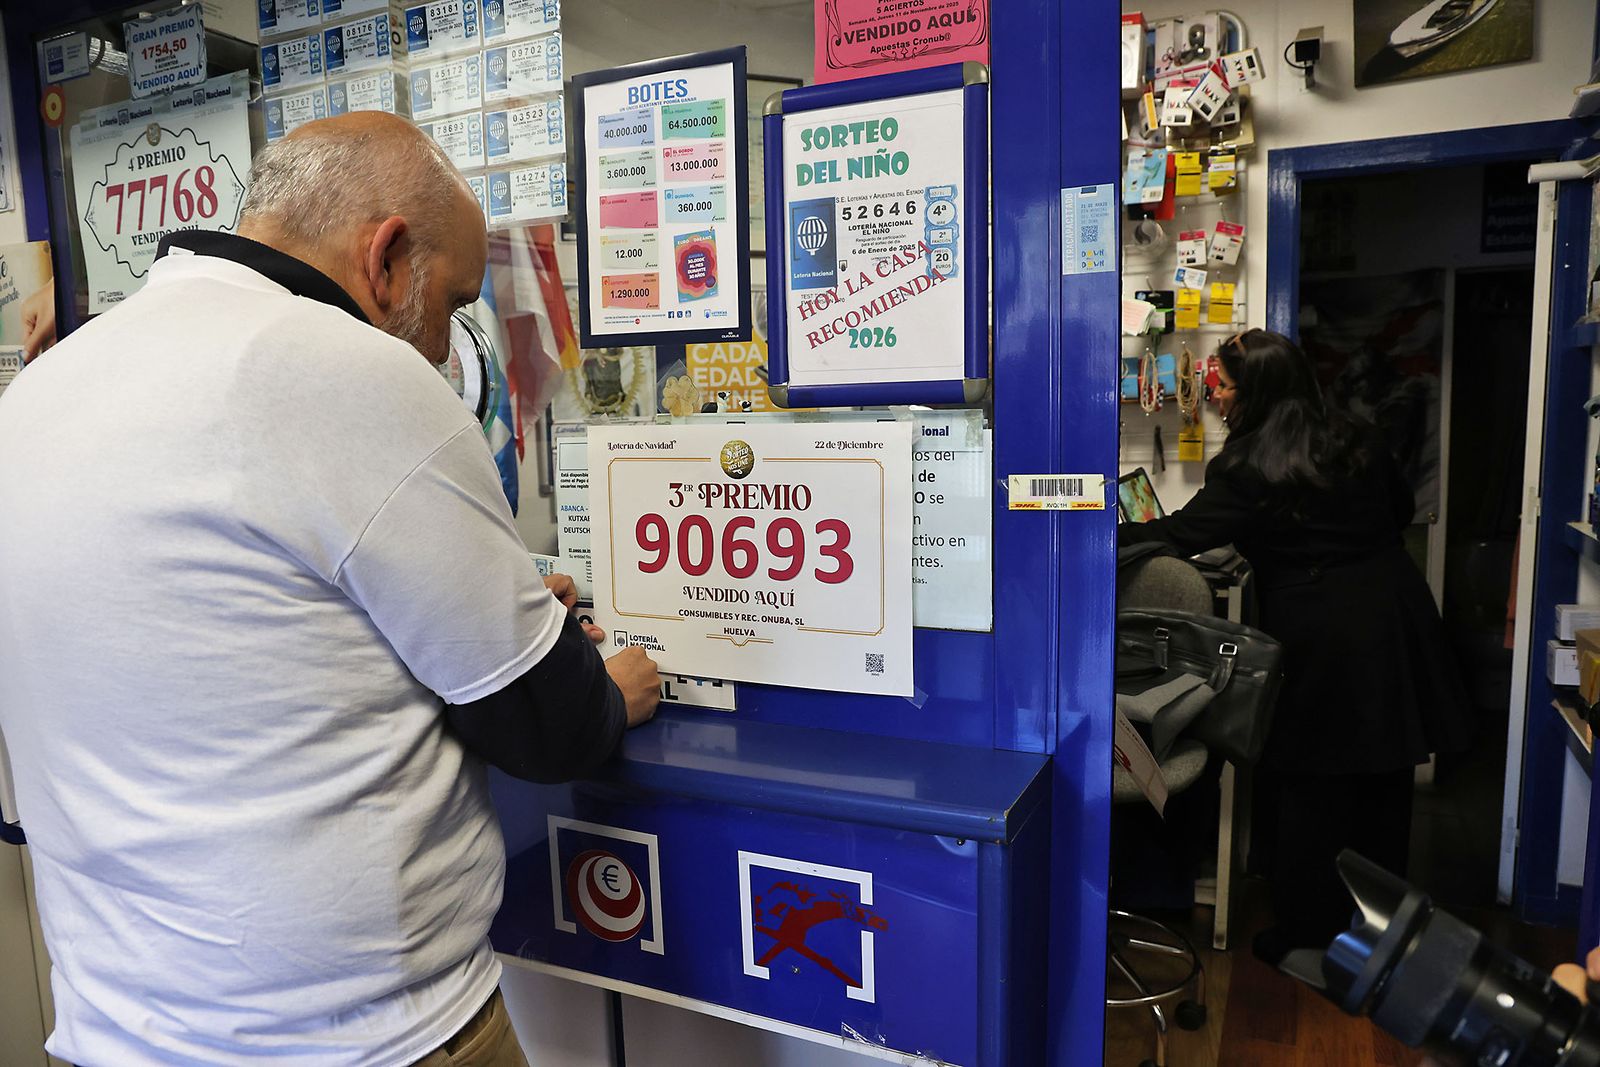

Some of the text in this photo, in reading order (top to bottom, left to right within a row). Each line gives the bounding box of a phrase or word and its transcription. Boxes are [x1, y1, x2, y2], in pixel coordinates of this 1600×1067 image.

[430, 4, 459, 17] 83181
[878, 14, 894, 22] Jueves
[910, 6, 938, 15] Noviembre
[884, 0, 925, 13] ACIERTOS
[132, 18, 195, 44] GRAN PREMIO
[346, 23, 373, 38] 08176
[844, 20, 921, 45] VENDIDO
[142, 38, 187, 61] 1754,50
[282, 42, 307, 55] 91376
[870, 32, 952, 54] Apuestas Cronub@
[512, 45, 542, 59] 09702
[137, 74, 175, 91] VENDIDO
[206, 87, 231, 99] Nacional
[628, 79, 688, 105] BOTES
[129, 107, 153, 120] Nacional
[512, 109, 544, 123] 03523
[668, 115, 718, 130] 64.500.000
[604, 124, 648, 139] 40.000.000
[800, 117, 899, 152] SORTEO
[136, 146, 186, 170] PREMIO
[670, 158, 719, 172] 13.000.000
[607, 166, 646, 179] 3.600.000
[796, 148, 910, 187] DEL NIÑO
[516, 171, 546, 183] 14274
[106, 165, 219, 235] 77768
[678, 201, 712, 213] 360.000
[842, 200, 917, 221] 52646
[933, 205, 947, 216] 4ª
[848, 220, 913, 232] LOTERÍA NACIONAL
[615, 249, 643, 259] 12.000
[936, 253, 949, 262] 20
[794, 269, 834, 279] Lotería Nacional
[797, 240, 934, 321] HOY LA CASA
[610, 288, 650, 299] 1.290.000
[806, 267, 948, 350] RECOMIENDA
[849, 326, 897, 349] 2026
[692, 344, 763, 364] CADA
[694, 366, 760, 387] EDAD
[698, 390, 765, 409] TINE
[607, 442, 635, 451] Lotería
[644, 440, 677, 450] Navidad
[815, 441, 884, 451] 22 de Diciembre
[918, 469, 936, 483] de
[698, 483, 812, 511] PREMIO
[929, 494, 944, 504] se
[635, 513, 856, 584] 90693
[949, 537, 966, 547] en
[682, 586, 795, 609] VENDIDO AQUÍ
[678, 609, 805, 626] CONSUMIBLES Y REC. ONUBA, SL
[630, 635, 658, 643] LOTERÍA
[723, 628, 756, 637] HUELVA
